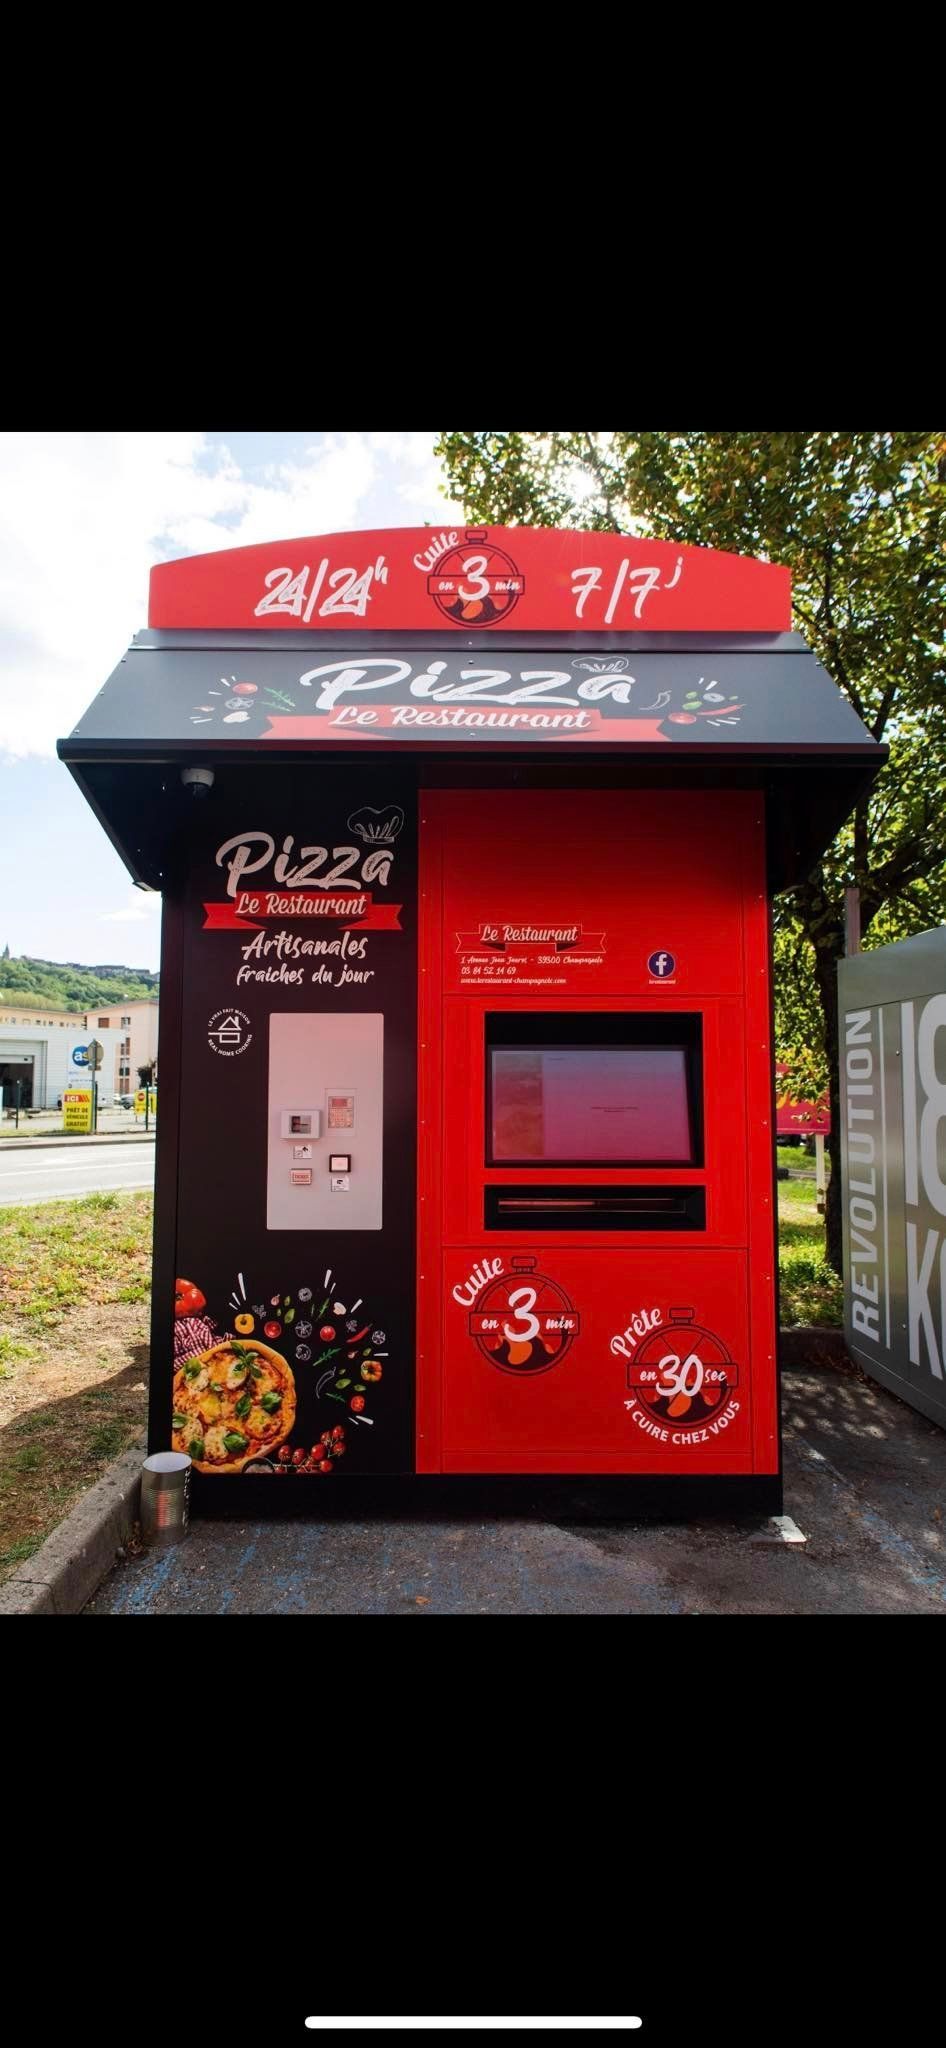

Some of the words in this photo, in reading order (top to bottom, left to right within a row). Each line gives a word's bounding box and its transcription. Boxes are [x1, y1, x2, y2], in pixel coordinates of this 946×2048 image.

[412, 530, 459, 574] Cuite
[438, 580, 454, 592] en
[456, 555, 490, 602] 3
[494, 579, 521, 592] min
[299, 657, 635, 710] Pizza
[333, 705, 379, 729] Le
[390, 705, 591, 729] Restaurant
[215, 831, 394, 898] Pizza
[235, 892, 260, 915] Le
[265, 893, 367, 915] Restaurant
[241, 930, 369, 961] Artisanales
[480, 926, 499, 941] Le
[502, 925, 578, 942] Restaurant
[312, 963, 333, 985] du
[333, 963, 375, 988] jour
[461, 966, 471, 975] 03
[845, 1010, 880, 1342] REVOLUTION
[452, 1255, 506, 1307] Cuite
[481, 1318, 500, 1330] en
[503, 1287, 541, 1343] 3
[545, 1315, 575, 1331] min
[610, 1306, 664, 1359] Prête
[639, 1369, 658, 1383] en
[655, 1353, 705, 1398] 30
[704, 1368, 728, 1383] sec
[631, 1409, 669, 1443] CUIRE
[671, 1430, 711, 1445] CHEZ
[709, 1400, 741, 1436] VOUS
